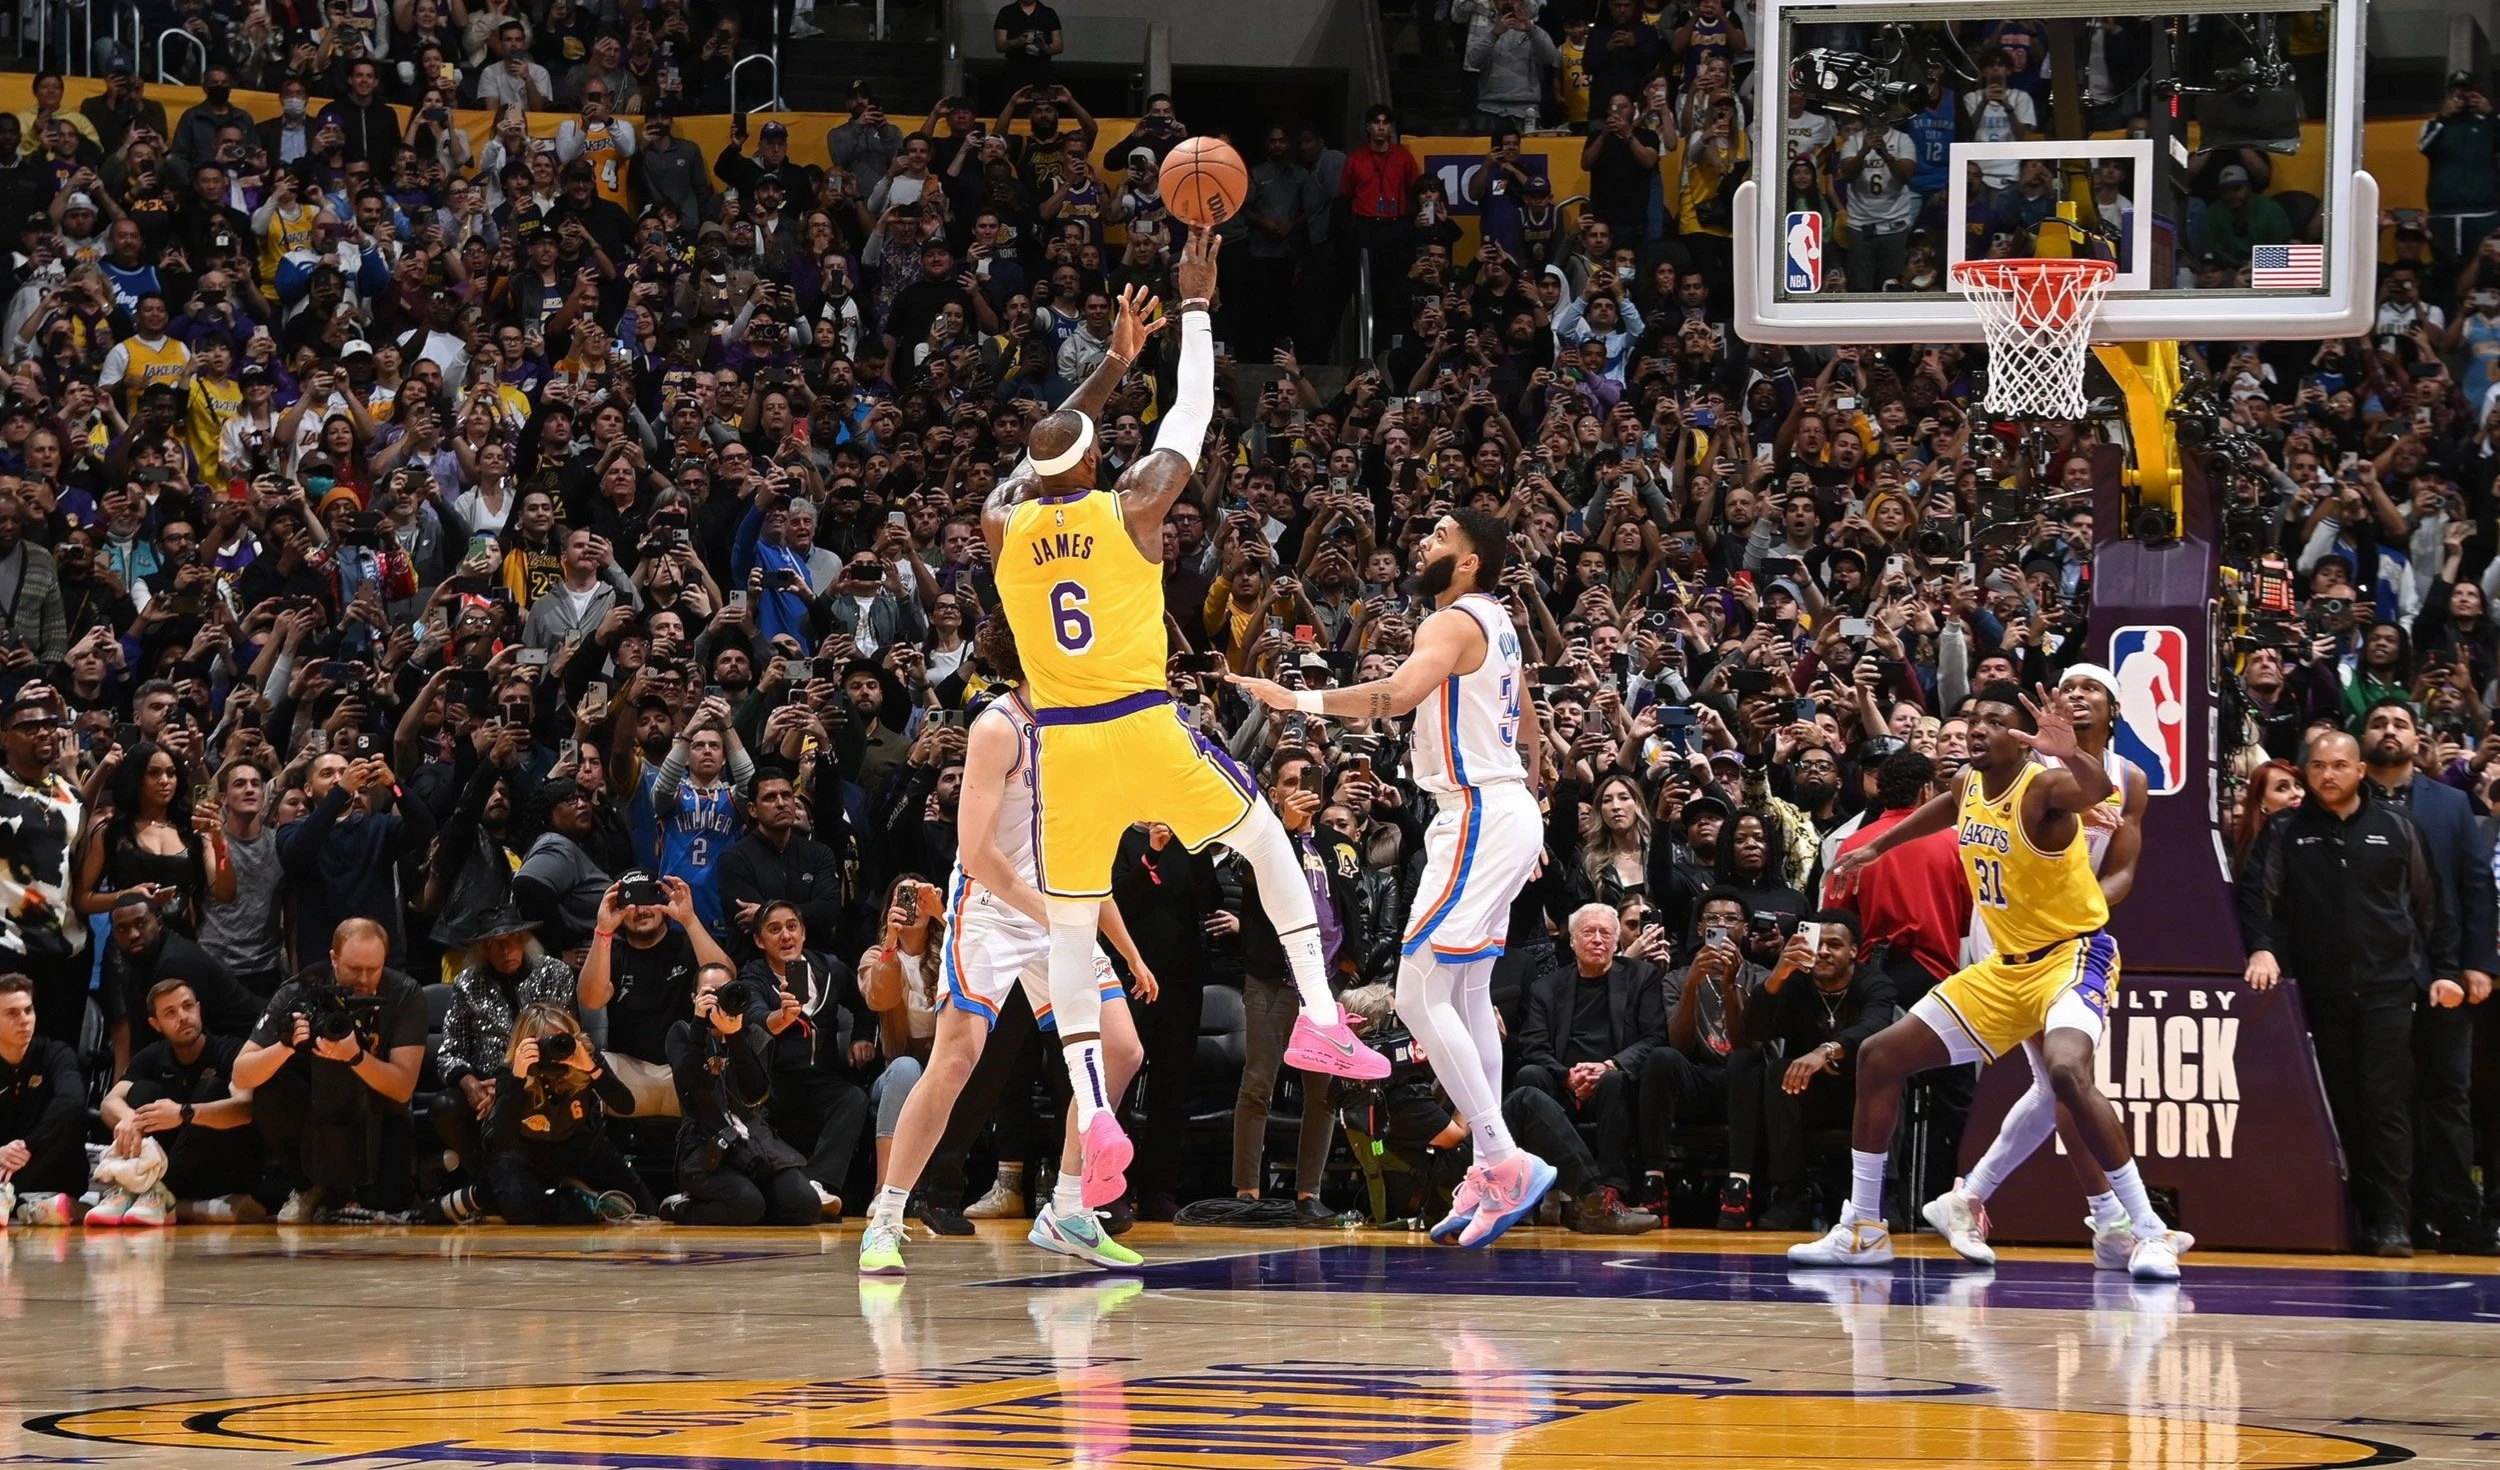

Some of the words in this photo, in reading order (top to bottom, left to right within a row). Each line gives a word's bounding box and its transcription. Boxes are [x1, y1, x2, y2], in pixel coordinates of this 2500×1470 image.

[1924, 142, 1942, 162] 12
[1869, 173, 1883, 196] 6
[1789, 274, 1808, 289] NBA
[1031, 533, 1094, 566] JAMES
[1049, 580, 1096, 657] 6
[1498, 674, 1520, 748] 34
[691, 838, 708, 867] 2
[1973, 857, 2010, 909] 31
[2189, 990, 2237, 1011] BY
[2094, 1015, 2241, 1102] LACK
[570, 1099, 585, 1120] 6
[2055, 1101, 2240, 1159] TORY
